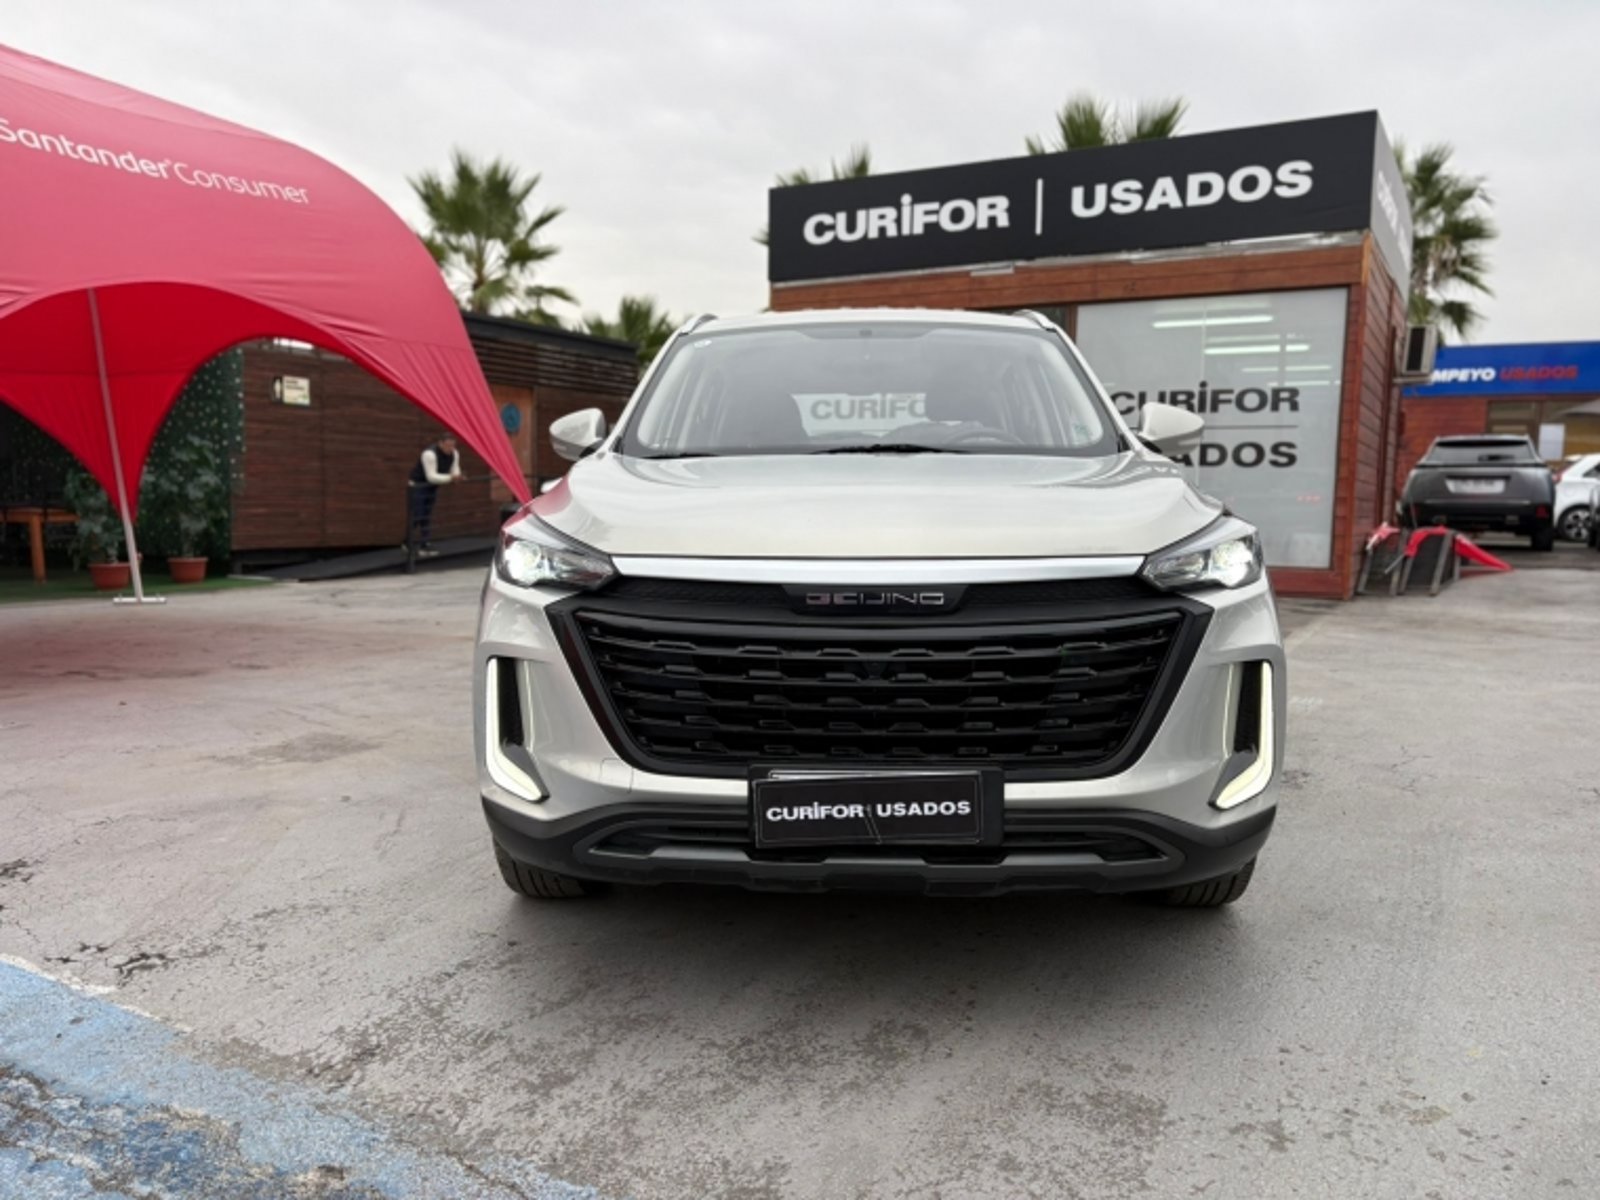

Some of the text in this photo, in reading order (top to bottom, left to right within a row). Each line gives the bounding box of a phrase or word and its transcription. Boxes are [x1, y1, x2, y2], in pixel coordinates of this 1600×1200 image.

[0, 118, 309, 204] Santander Consumer
[1071, 160, 1314, 219] USADOS
[1500, 366, 1578, 380] USADOS
[876, 801, 971, 817] USADOS
